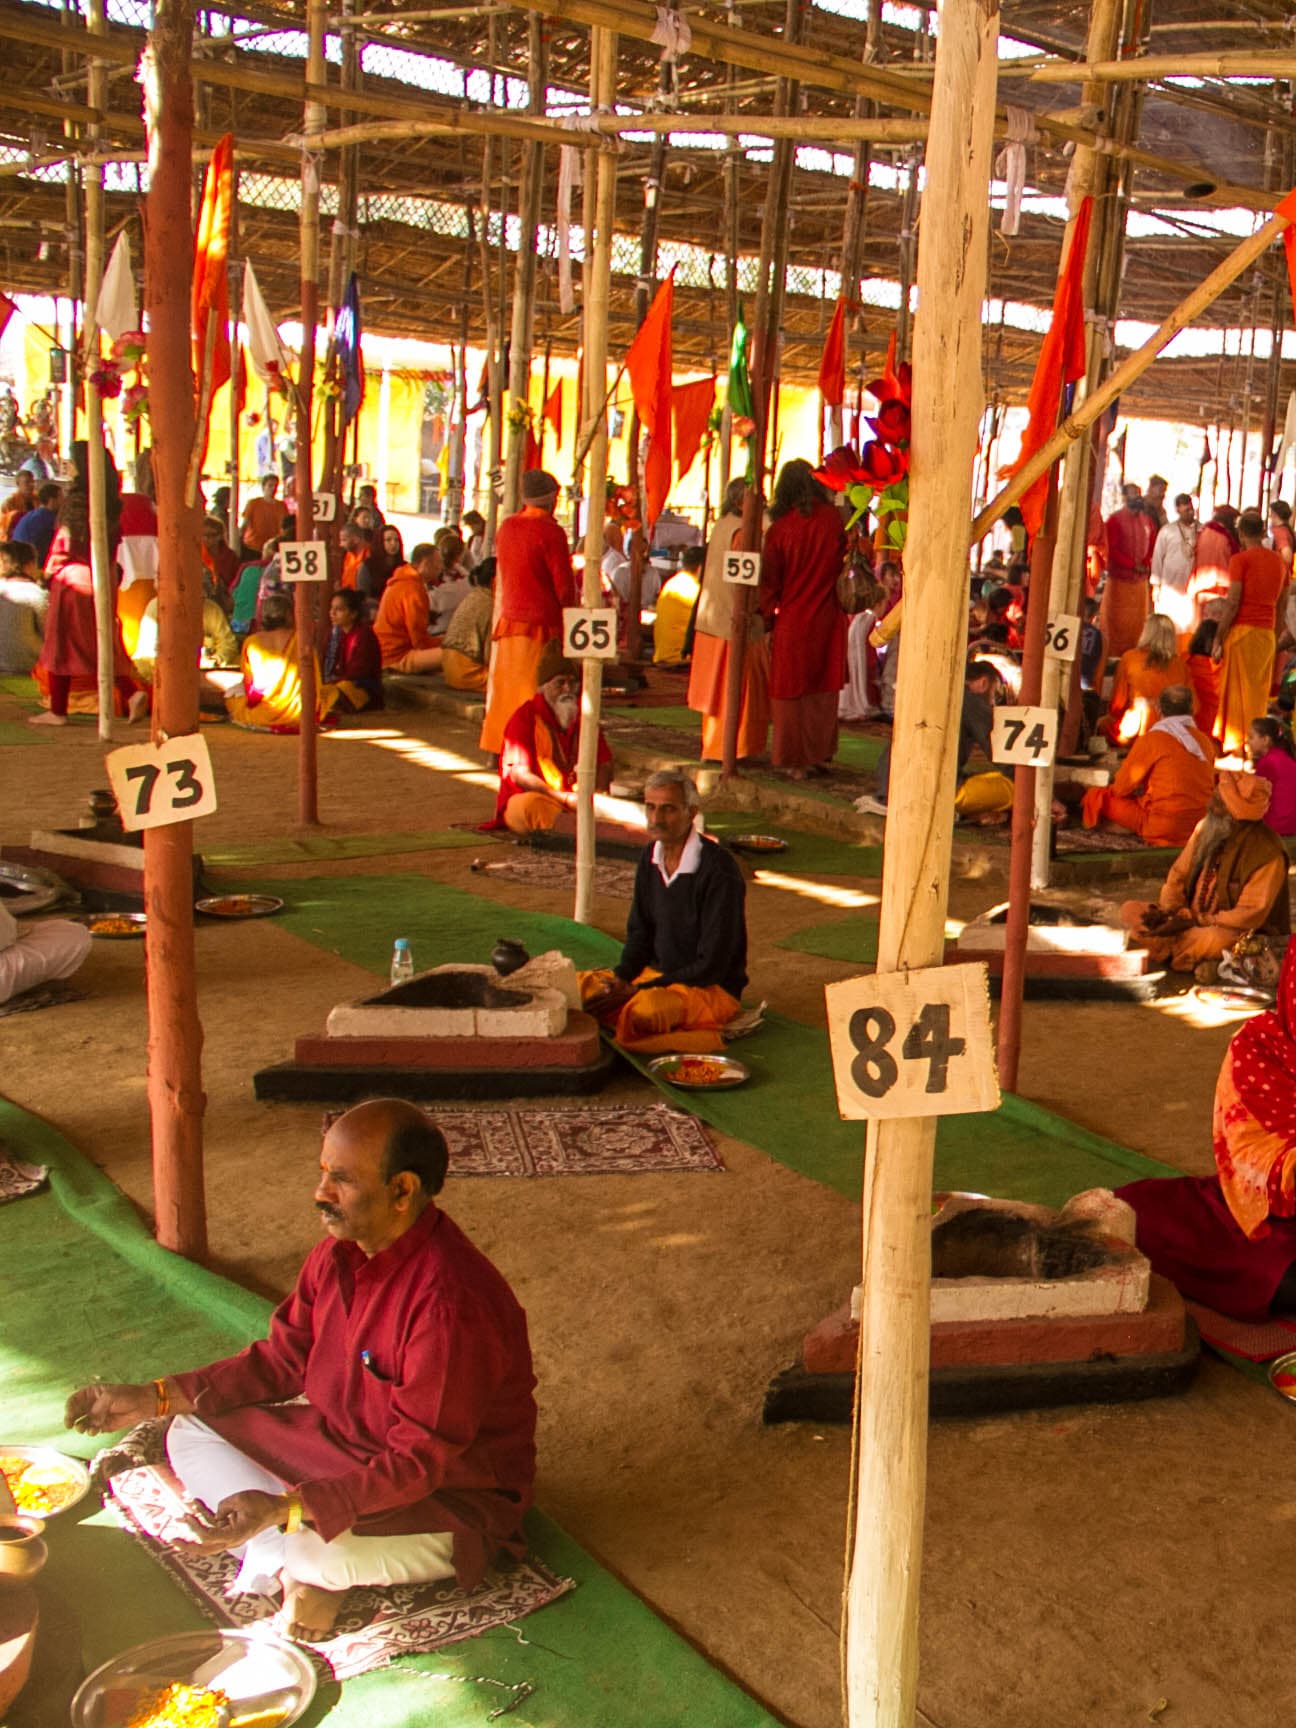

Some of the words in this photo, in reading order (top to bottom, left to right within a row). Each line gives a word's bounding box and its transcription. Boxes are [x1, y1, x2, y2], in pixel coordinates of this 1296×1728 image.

[285, 550, 318, 575] 58
[727, 557, 755, 579] 59
[569, 618, 609, 650] 65
[1003, 719, 1048, 757] 74
[126, 759, 203, 815] 73
[849, 1003, 967, 1099] 84
